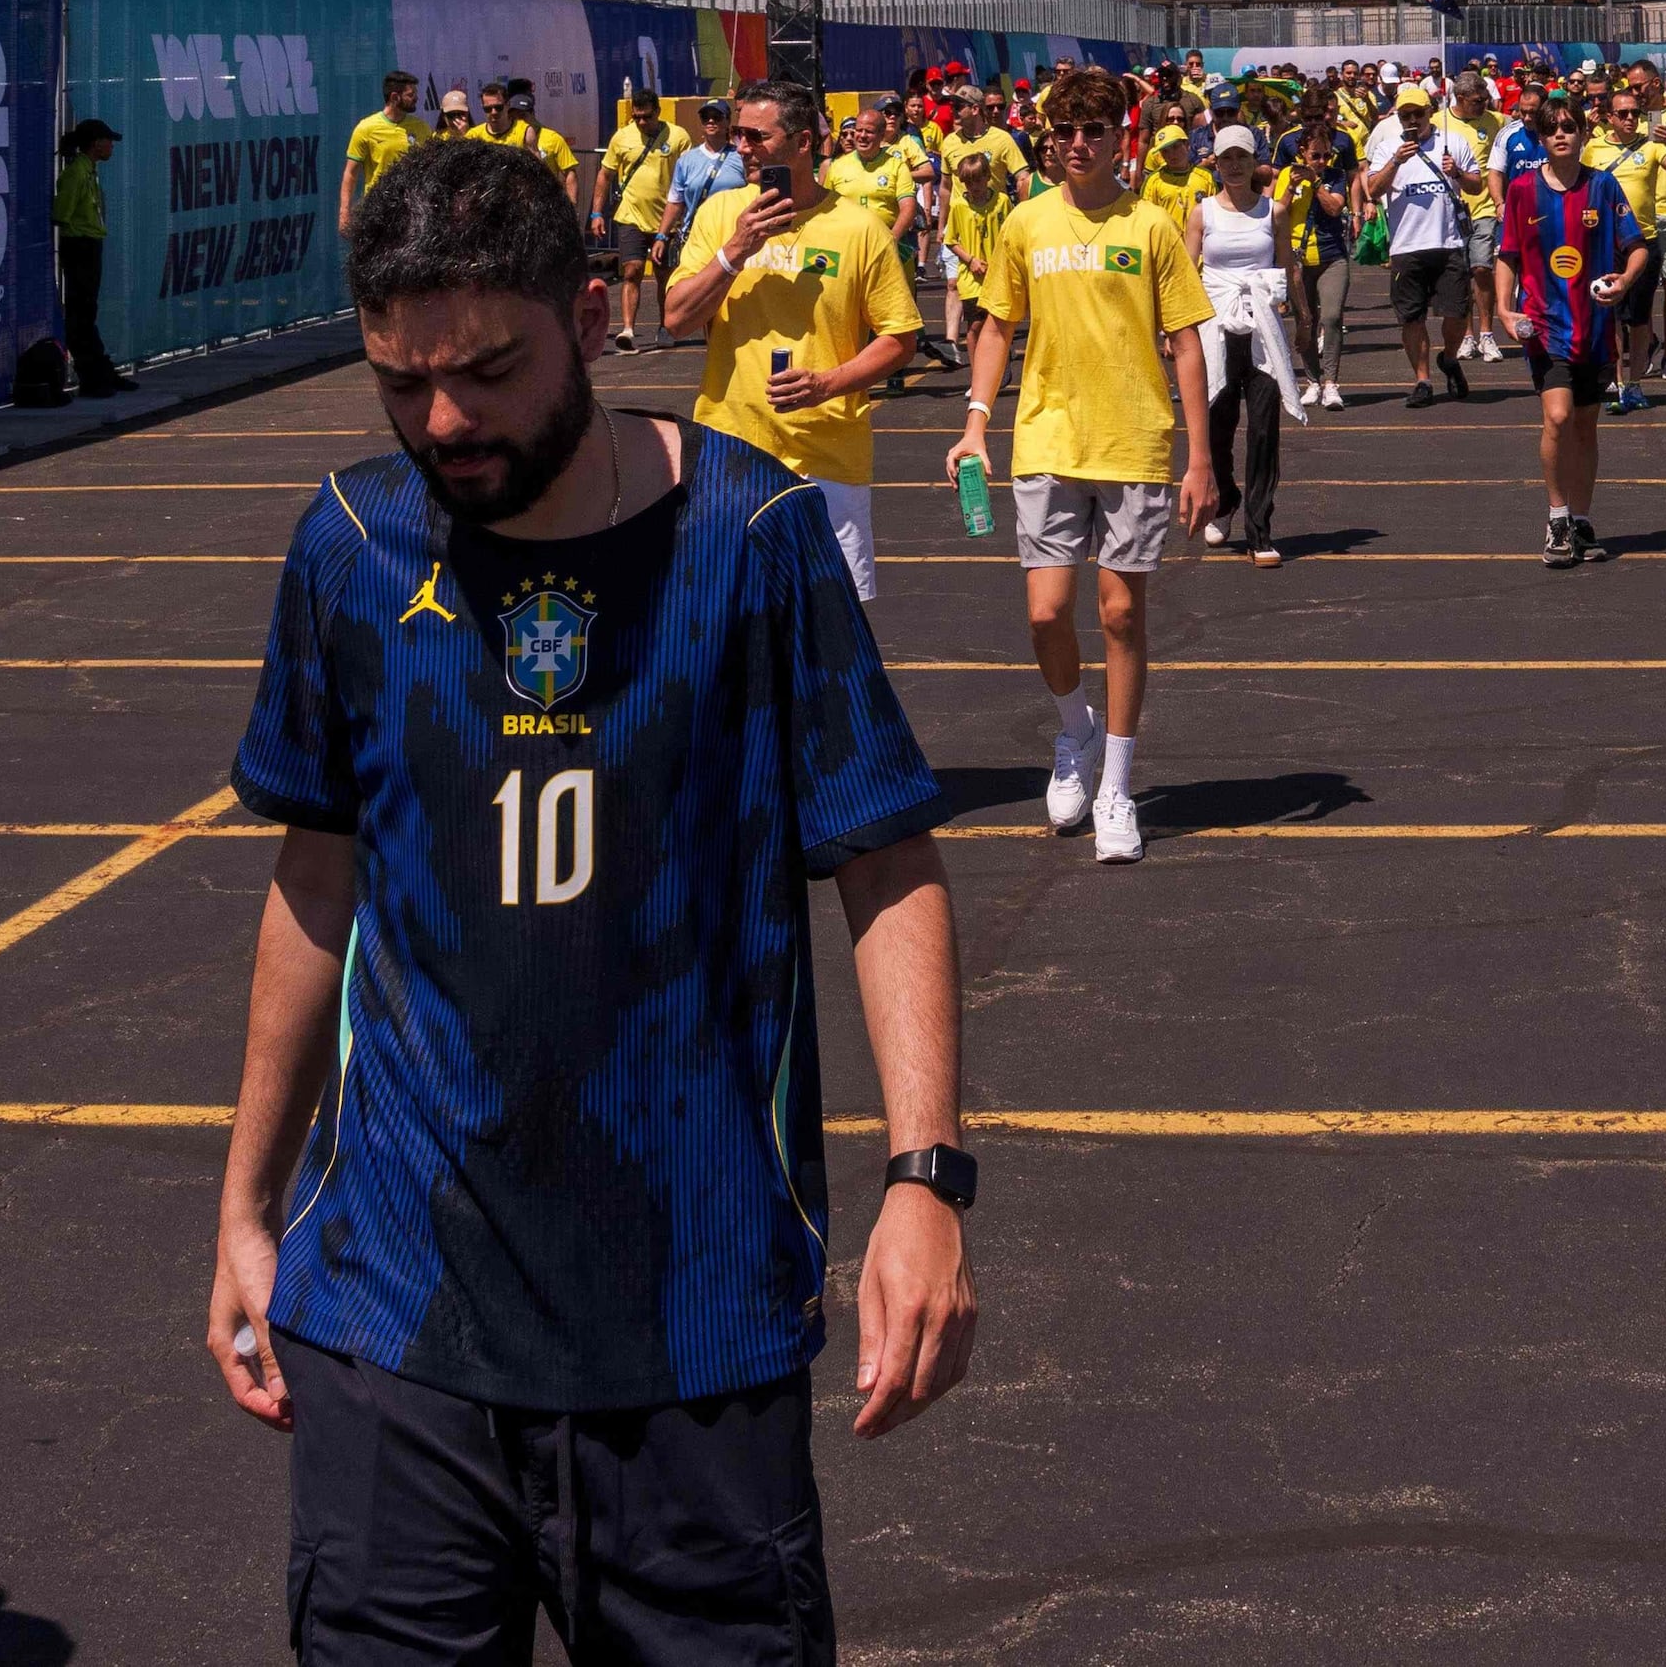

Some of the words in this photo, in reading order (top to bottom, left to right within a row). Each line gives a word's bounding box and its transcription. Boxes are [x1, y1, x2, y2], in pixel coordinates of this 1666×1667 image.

[151, 33, 236, 122] WE
[234, 34, 319, 118] ARE
[170, 140, 241, 213] NEW
[247, 135, 320, 202] YORK
[159, 224, 237, 300] NEW
[234, 212, 315, 284] JERSEY
[1033, 244, 1104, 277] BRASIL
[530, 639, 563, 653] CBF
[502, 714, 592, 735] BRASIL
[492, 769, 594, 905] 10
